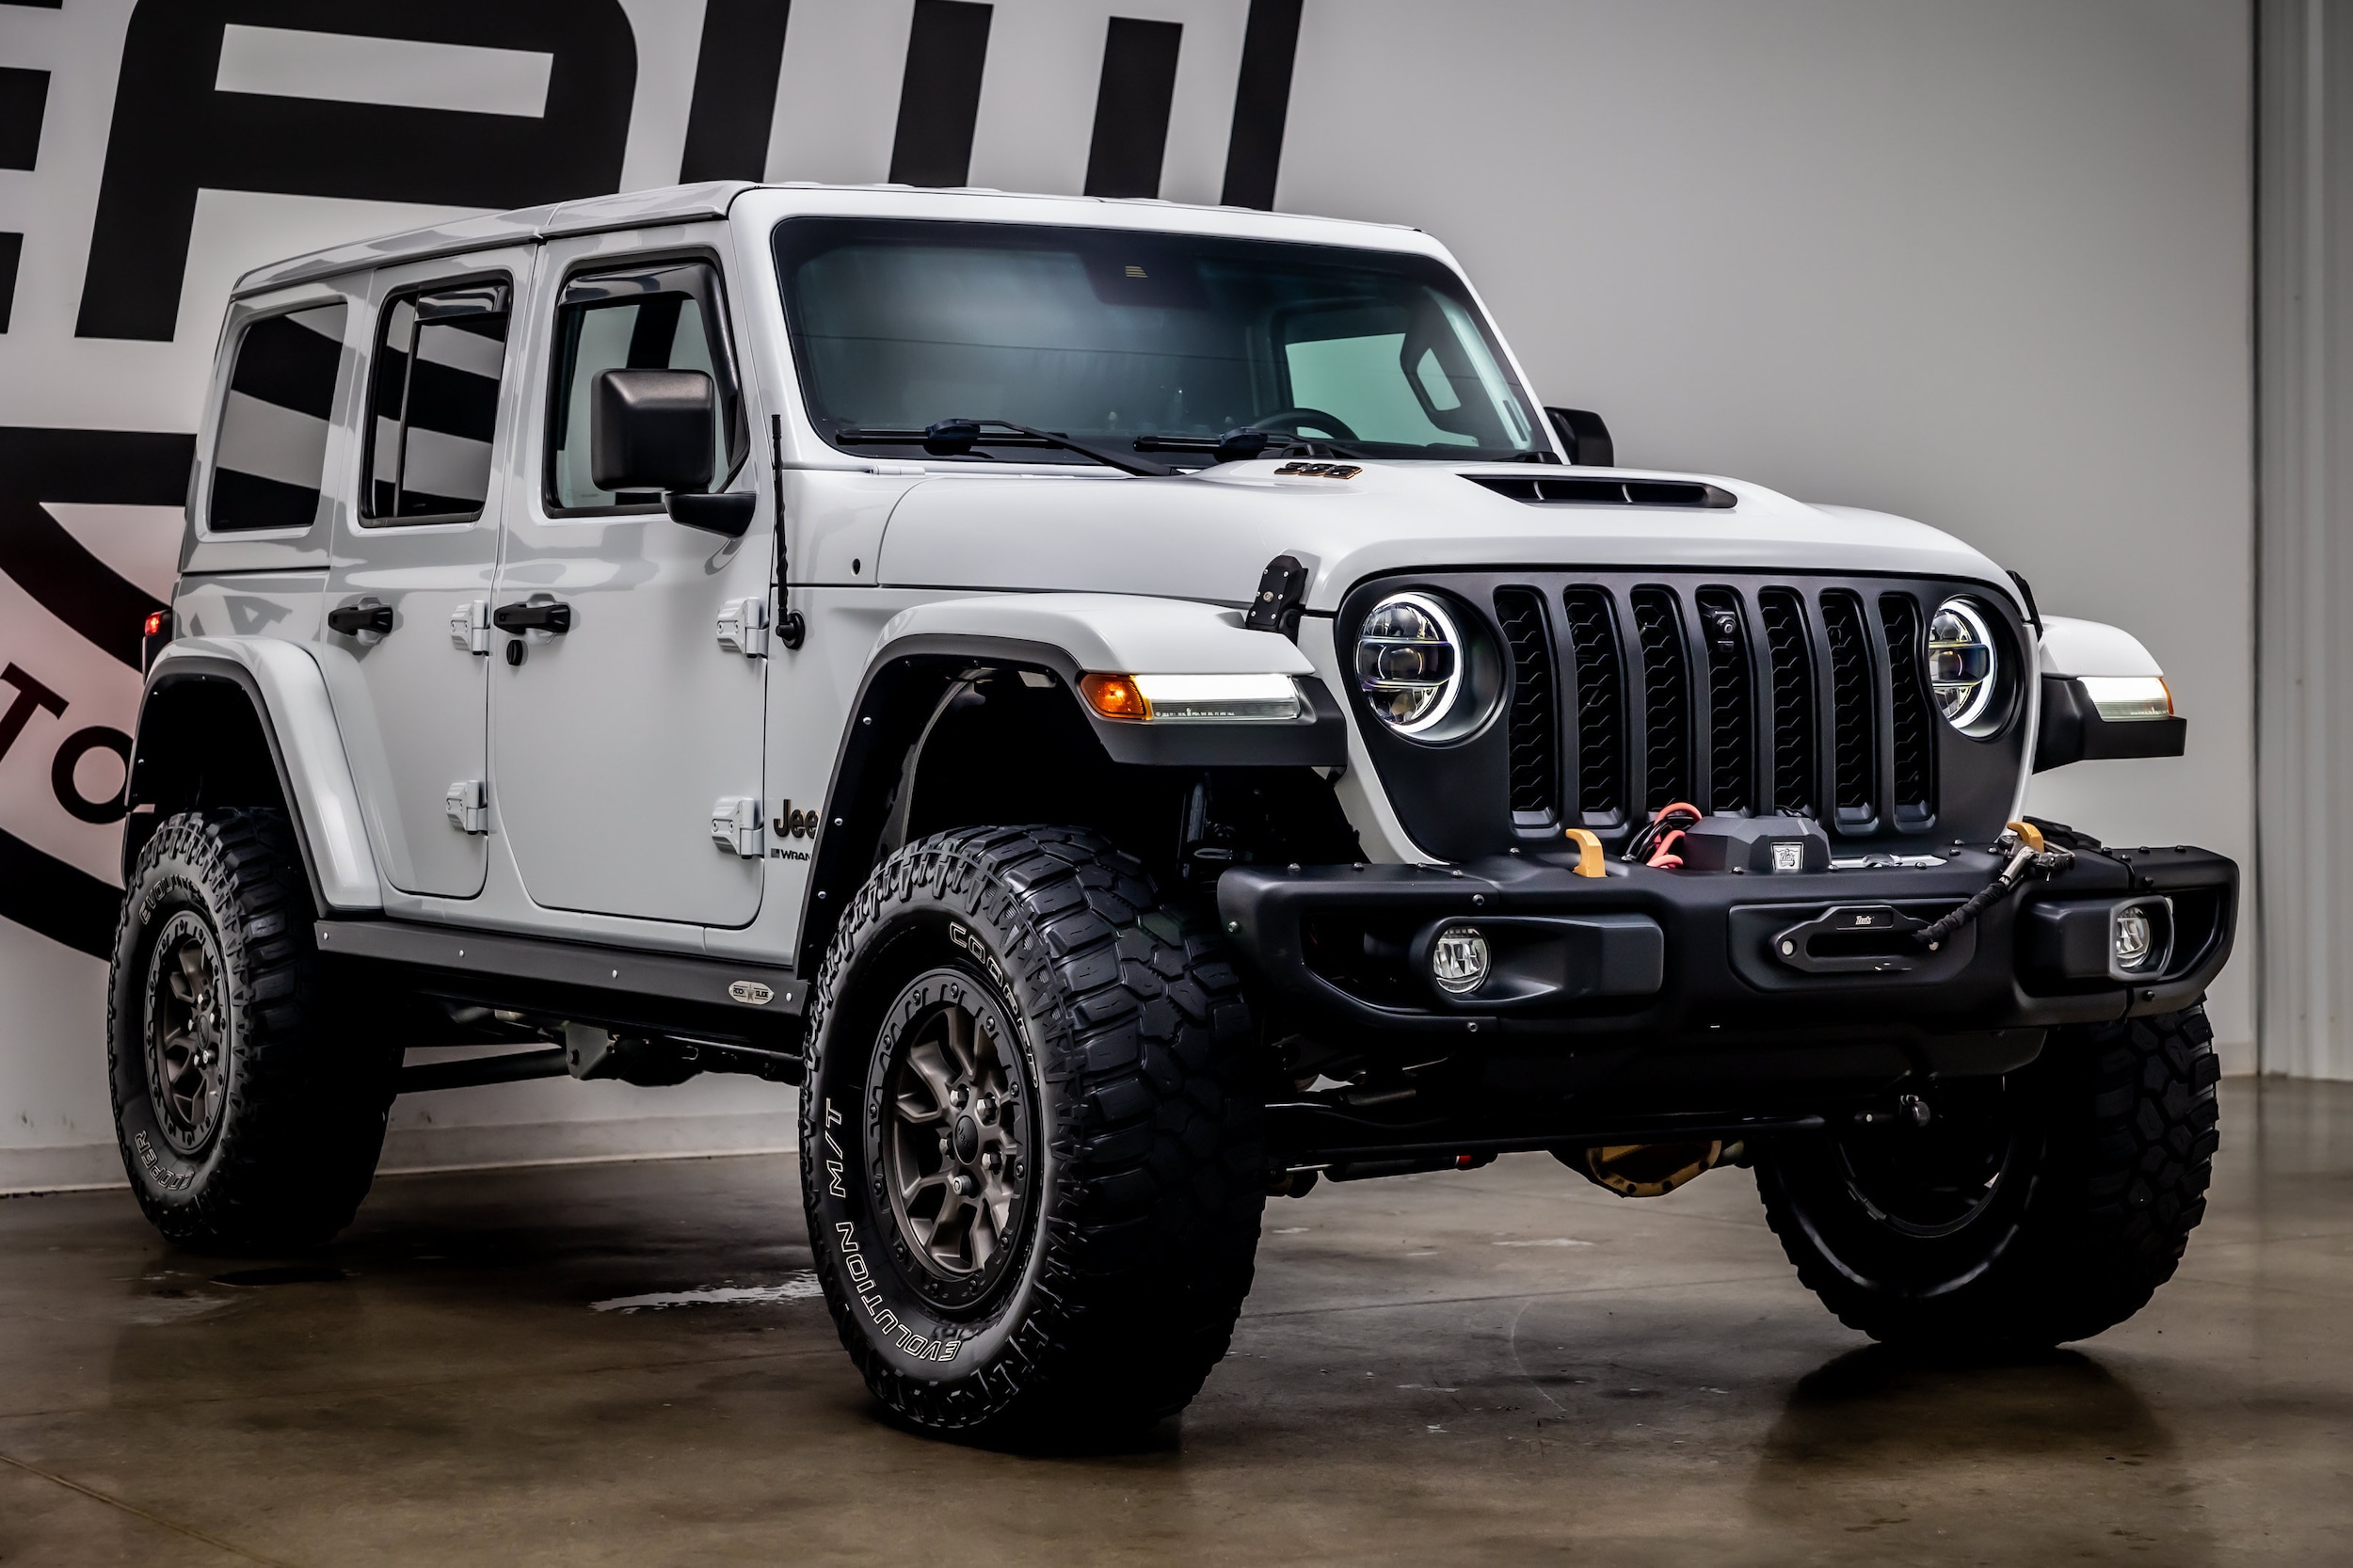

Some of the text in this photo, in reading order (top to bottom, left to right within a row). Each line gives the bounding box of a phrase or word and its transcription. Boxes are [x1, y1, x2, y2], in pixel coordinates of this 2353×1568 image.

[949, 920, 1039, 1089] COOPER
[135, 1129, 195, 1190] COOPER
[824, 1097, 962, 1362] EVOLUTION M/T
